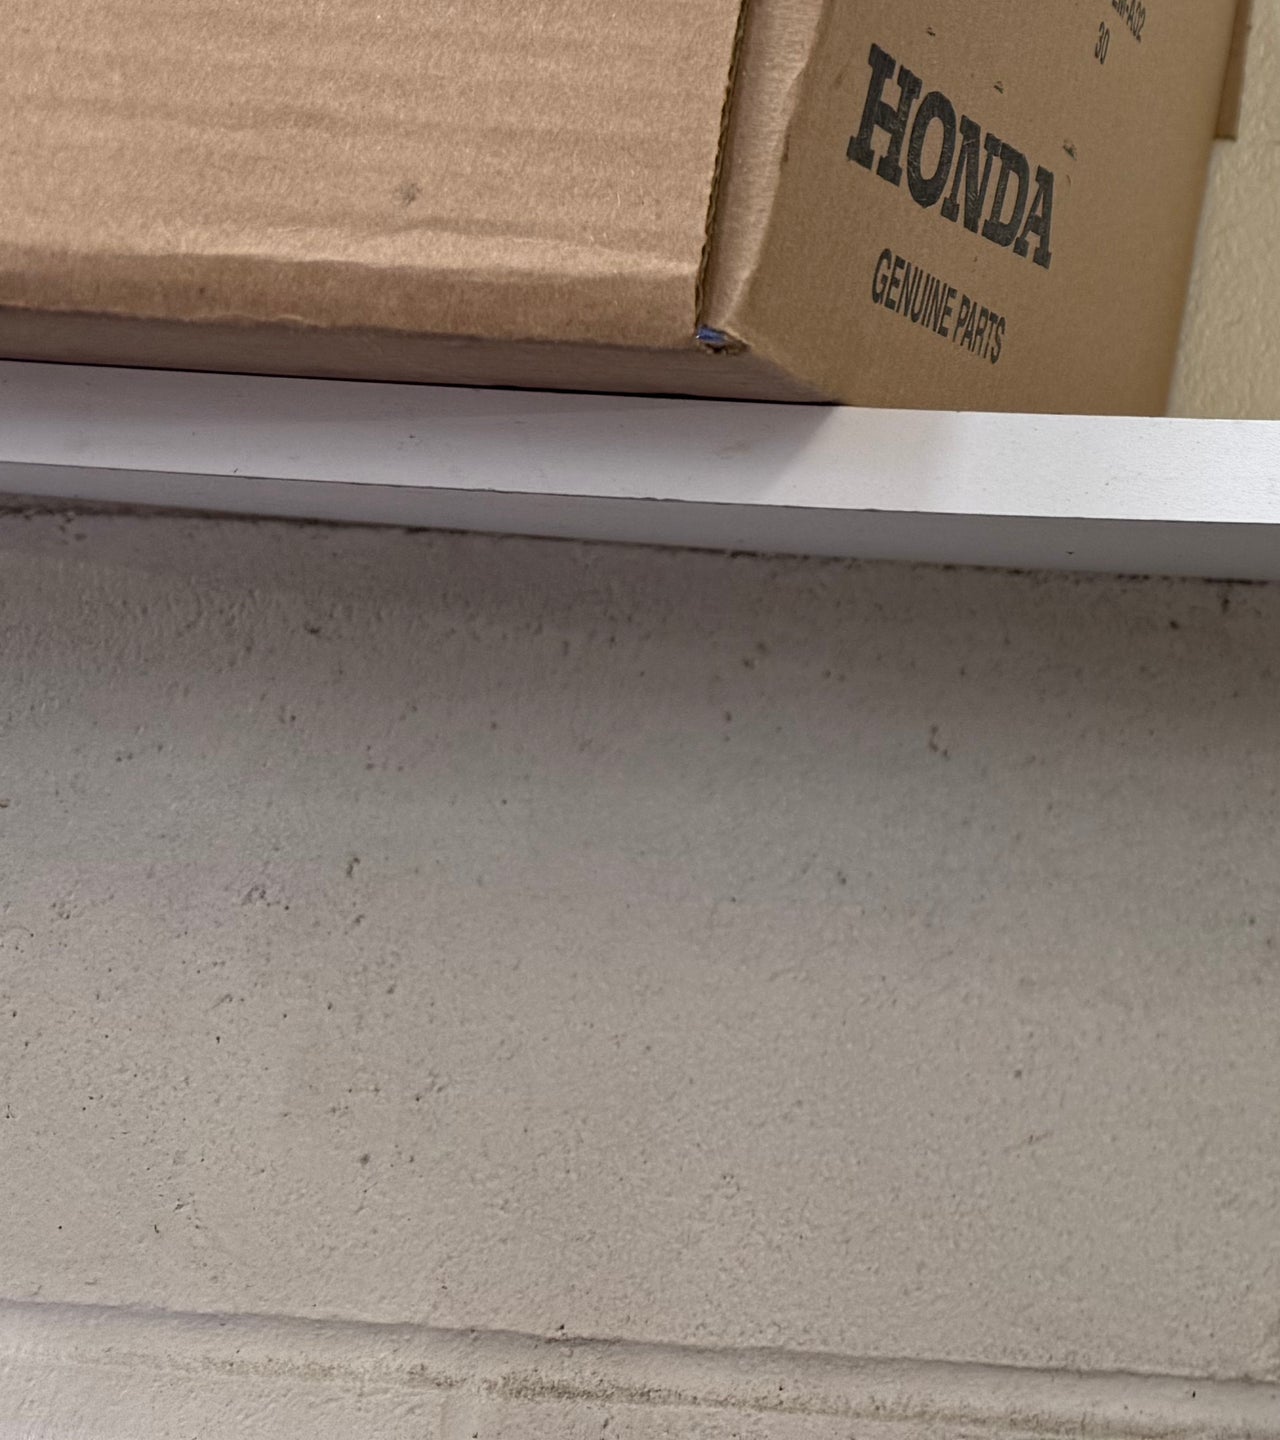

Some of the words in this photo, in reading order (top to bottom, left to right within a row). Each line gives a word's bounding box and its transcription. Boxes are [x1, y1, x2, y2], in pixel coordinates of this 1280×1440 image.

[1094, 21, 1111, 65] 30
[846, 43, 1055, 269] HONDA
[871, 248, 958, 338] GENUINE
[953, 293, 1006, 364] PARTS
